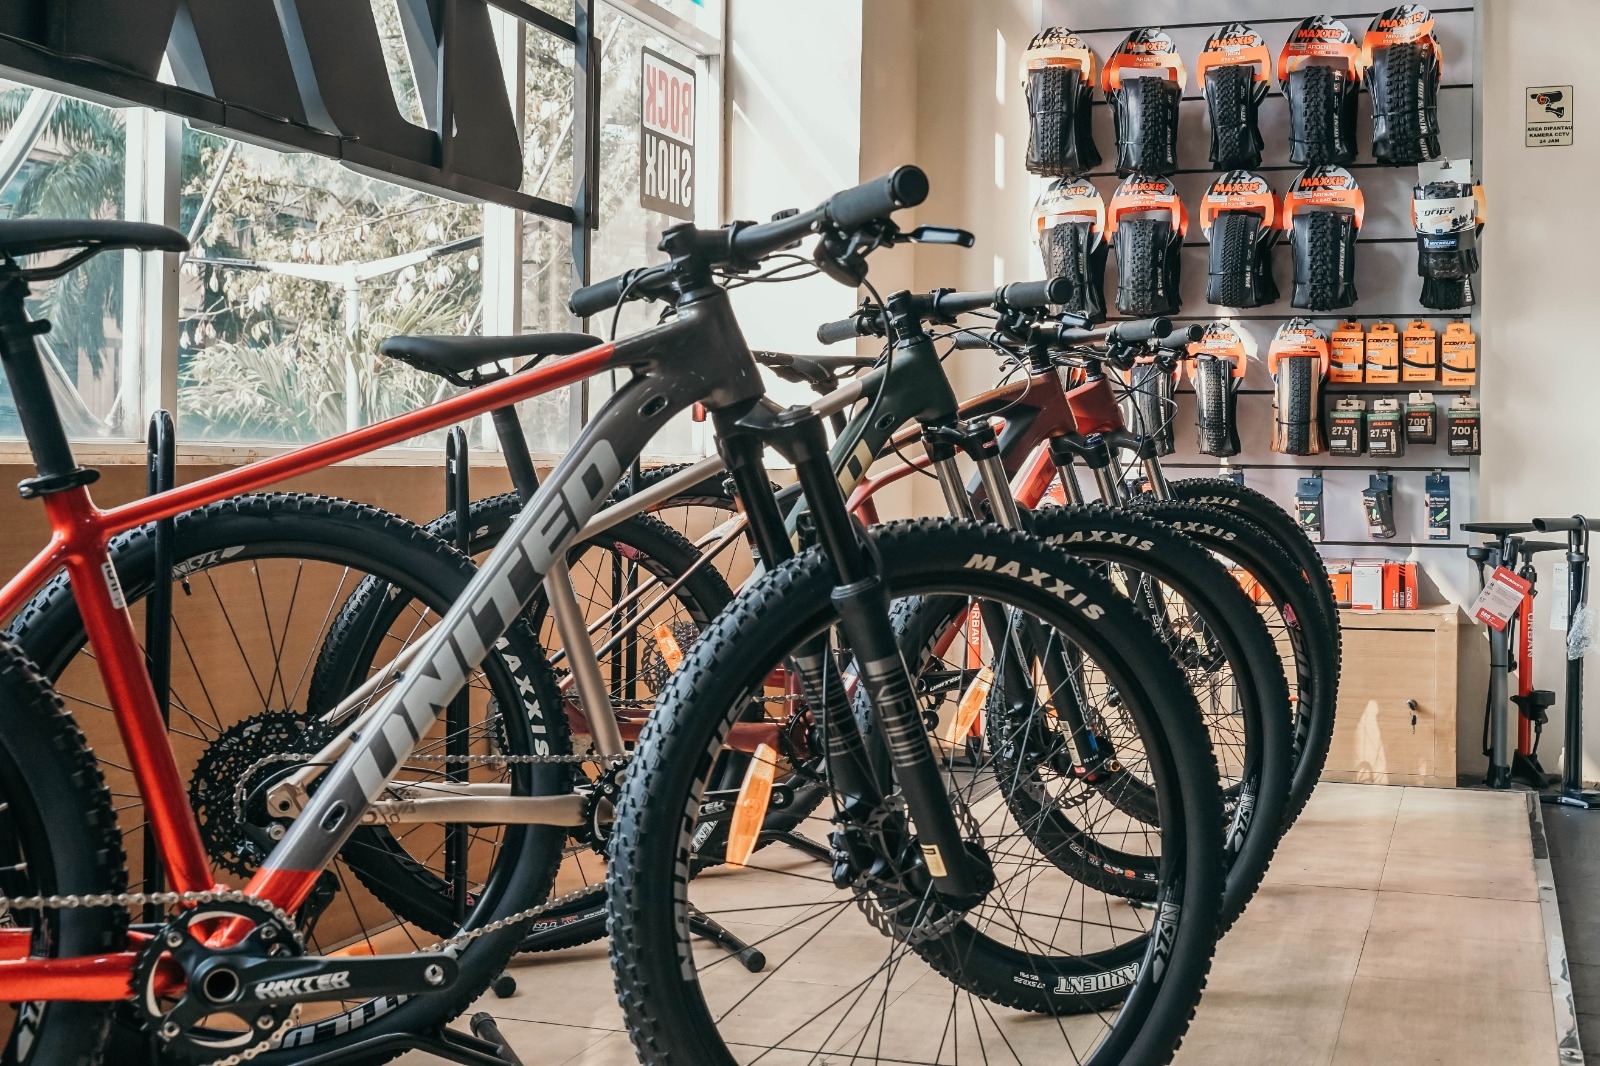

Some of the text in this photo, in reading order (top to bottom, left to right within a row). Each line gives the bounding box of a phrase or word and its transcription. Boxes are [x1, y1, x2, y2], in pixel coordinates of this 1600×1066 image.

[1379, 11, 1422, 28] MAXXIS
[1298, 29, 1341, 38] MAXXIS
[1033, 37, 1077, 46] MAXXIS
[1126, 41, 1168, 51] MXXIS
[1209, 36, 1255, 48] MAXXIS
[1213, 182, 1260, 192] MAXXIS
[1301, 176, 1346, 187] MAXXIS
[1122, 183, 1166, 192] MAXXIS
[1280, 328, 1314, 336] MAXXIS
[1332, 427, 1352, 435] 27.5"
[1370, 429, 1390, 437] 27.5"
[1452, 427, 1470, 435] 700
[1188, 496, 1240, 507] AXXIS
[1170, 522, 1237, 540] AXXIS
[1044, 530, 1154, 551] MAXXIS
[964, 553, 1105, 620] MAXXIS
[353, 439, 621, 803] UNITED
[1053, 962, 1140, 994] ARDENT
[254, 970, 351, 1000] UNITED
